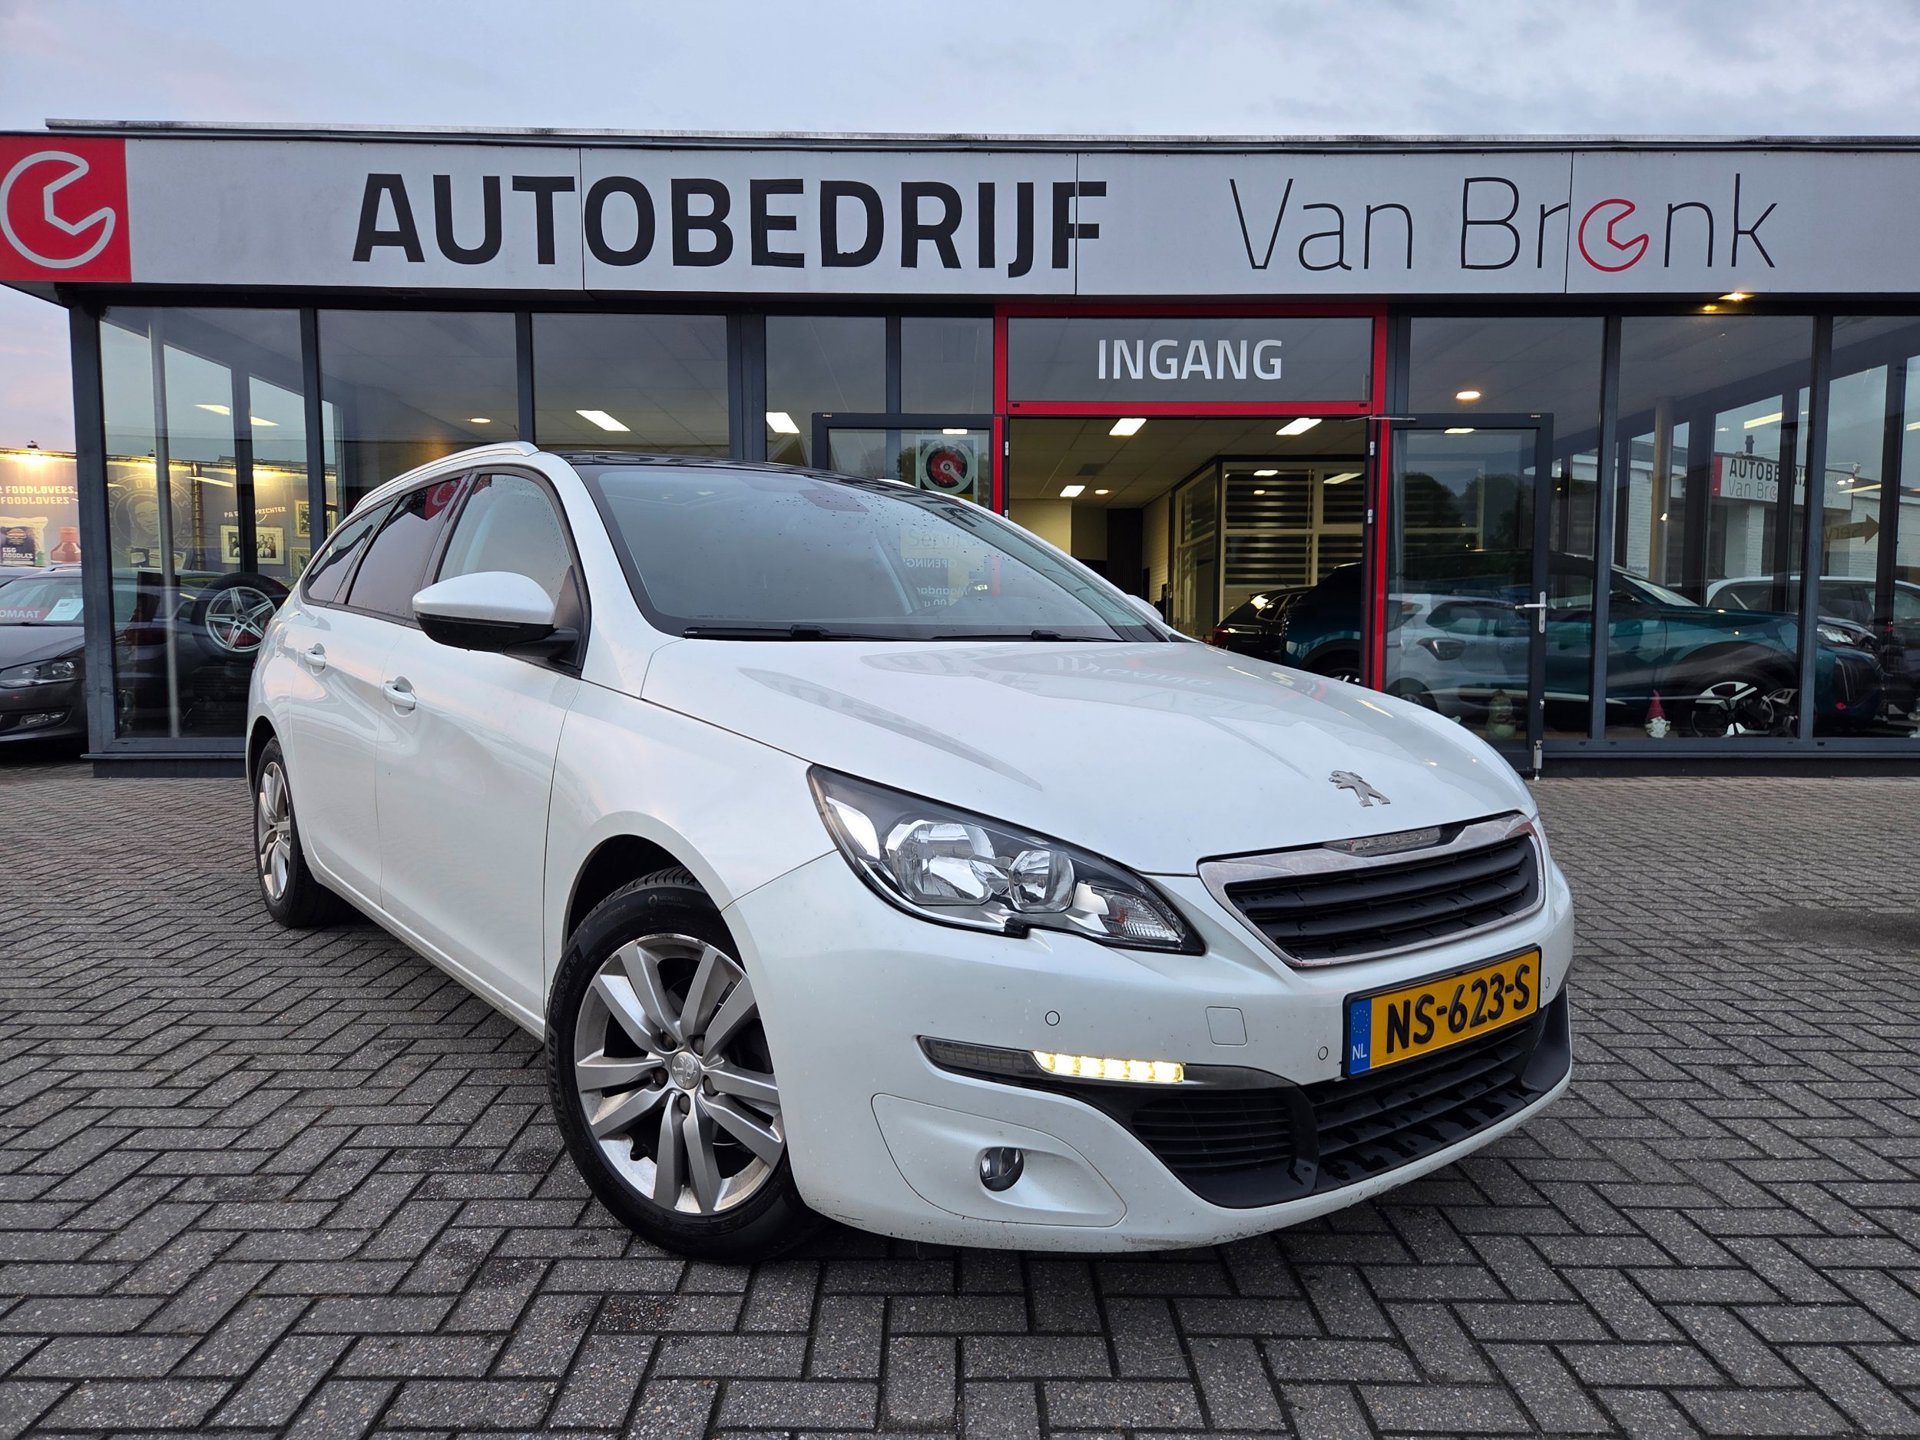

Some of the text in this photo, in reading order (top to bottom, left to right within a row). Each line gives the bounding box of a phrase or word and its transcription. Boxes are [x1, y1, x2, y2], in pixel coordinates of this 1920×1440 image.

[351, 173, 1107, 278] AUTOBEDRIJF
[1229, 177, 1414, 271] Van
[1098, 339, 1283, 381] INGANG
[1386, 964, 1530, 1054] NS-623-S
[1352, 1043, 1367, 1061] NL
